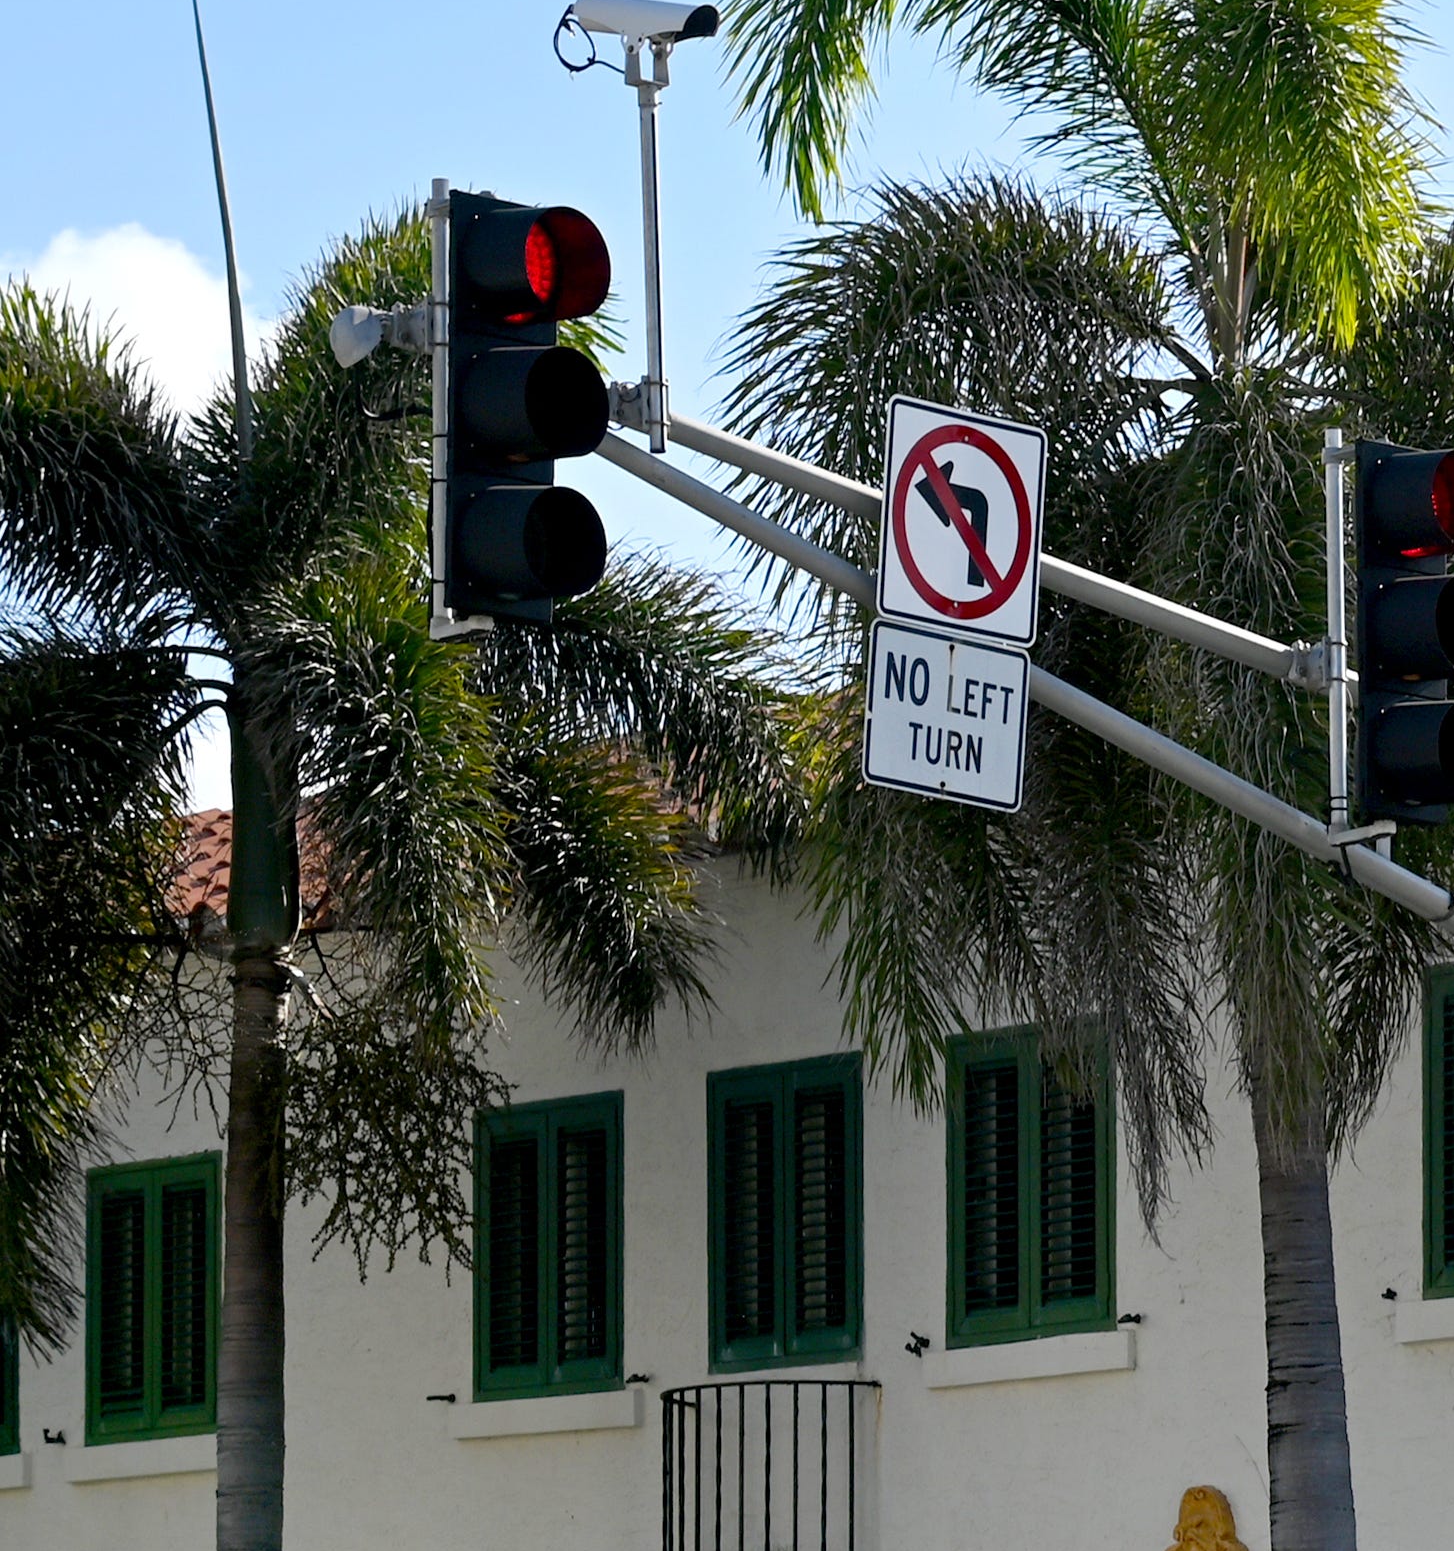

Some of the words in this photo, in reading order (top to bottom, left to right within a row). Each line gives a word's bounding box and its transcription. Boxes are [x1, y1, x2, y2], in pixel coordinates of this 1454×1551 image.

[884, 651, 930, 707] NO
[946, 674, 1015, 725] LEFT
[908, 721, 983, 774] TURN
